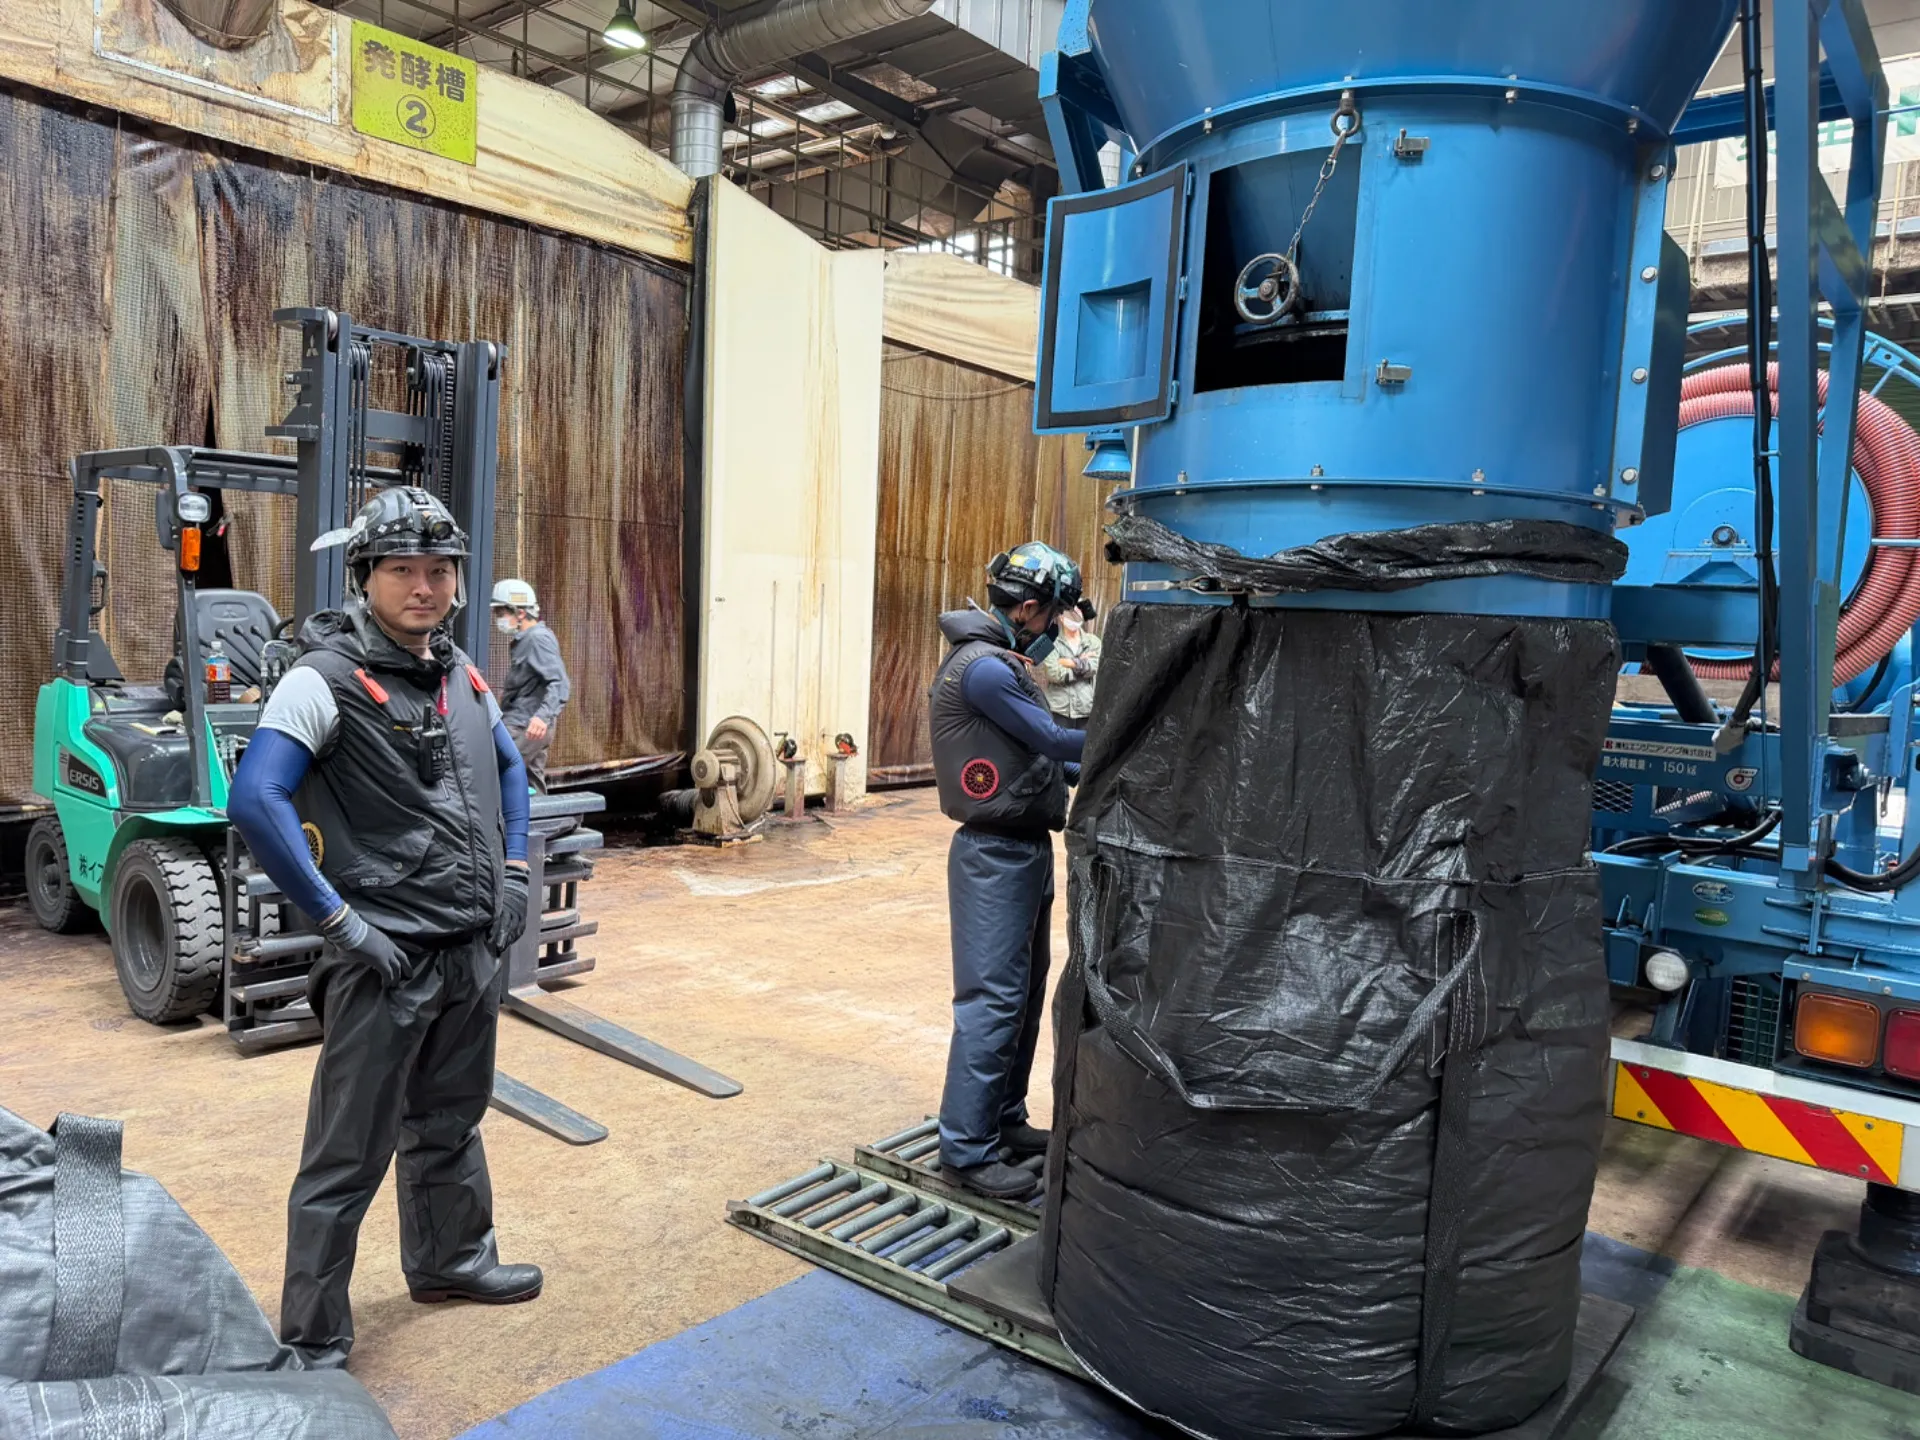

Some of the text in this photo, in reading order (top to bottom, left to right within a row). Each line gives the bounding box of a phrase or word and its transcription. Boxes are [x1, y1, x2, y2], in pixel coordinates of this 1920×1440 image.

[364, 39, 466, 103] 発酵槽
[1663, 761, 1685, 774] 150
[69, 768, 99, 790] ERSIS
